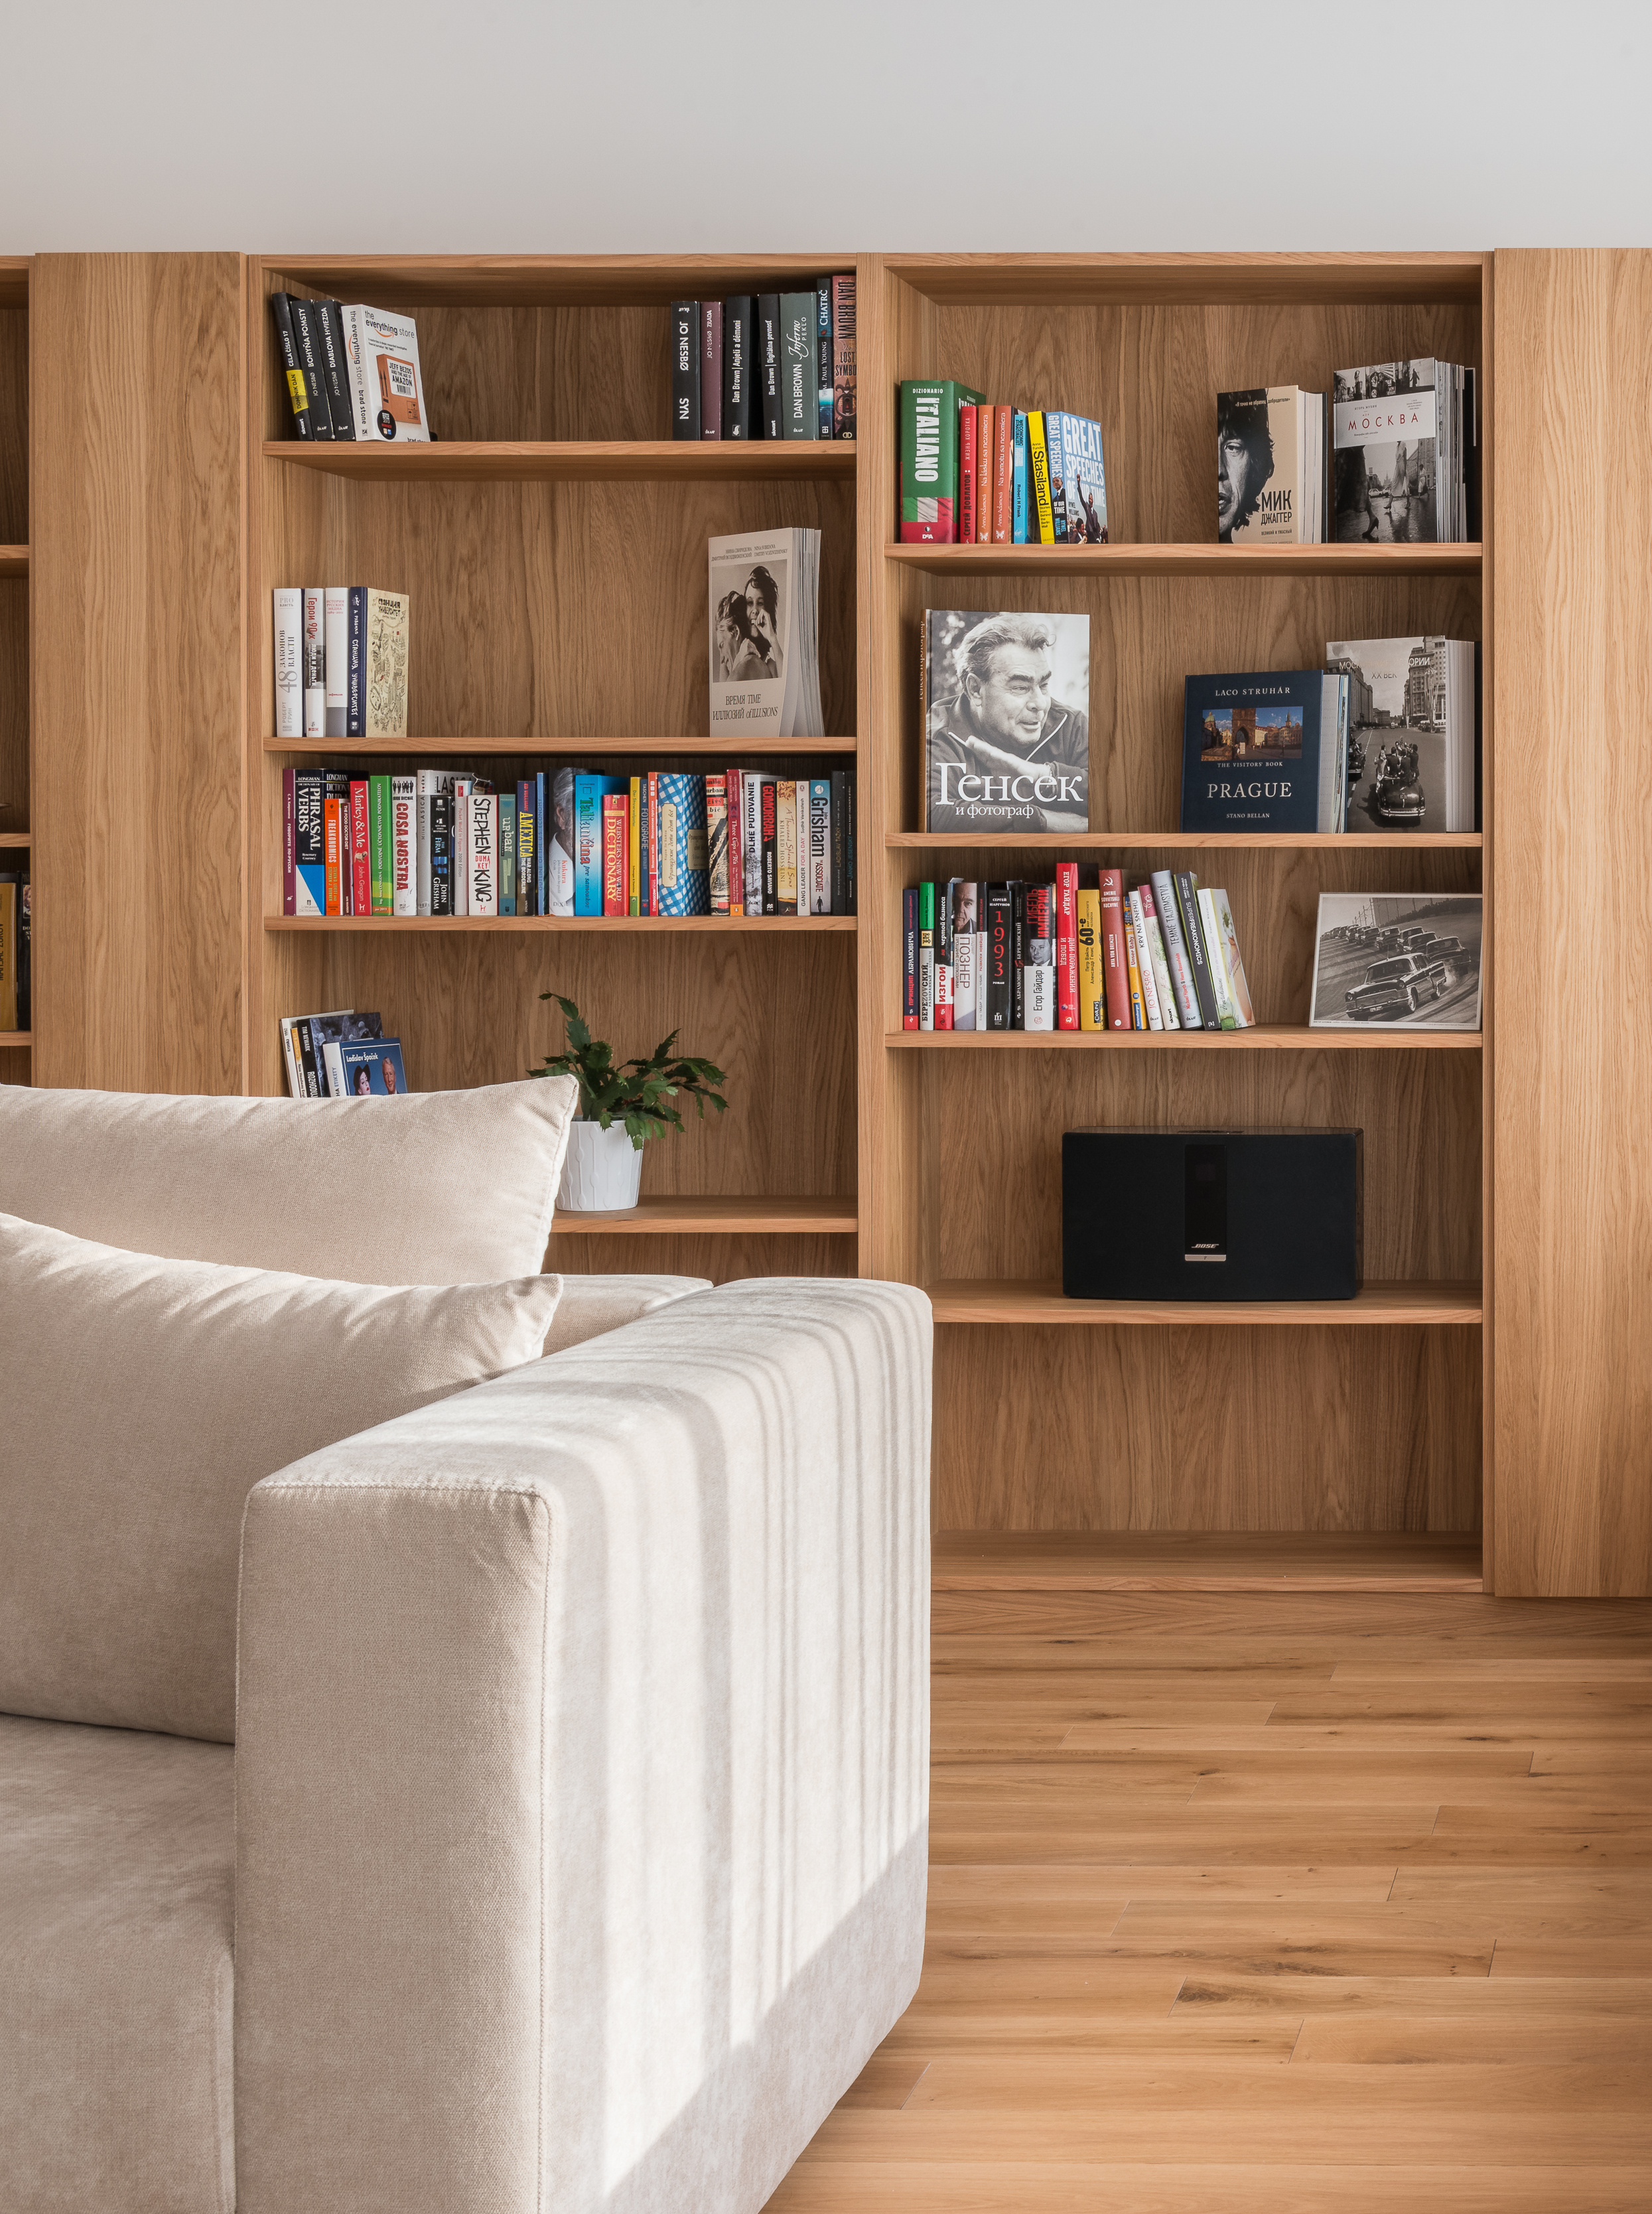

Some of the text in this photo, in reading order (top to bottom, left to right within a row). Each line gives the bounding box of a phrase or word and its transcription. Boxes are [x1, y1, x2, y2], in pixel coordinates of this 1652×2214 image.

[365, 311, 374, 320] the
[819, 290, 828, 326] CHATRČ
[838, 282, 856, 339] DAN BROWN
[299, 309, 314, 367] BOHYŇA POMSTY
[320, 307, 336, 368] DIABLOVA HVIEZDA
[352, 324, 361, 364] everything
[366, 320, 415, 338] everything store
[679, 321, 689, 334] JO
[679, 338, 689, 371] NESBØ
[841, 352, 855, 363] LOST
[392, 376, 412, 386] AMAZON
[793, 364, 802, 397] BROWN
[679, 398, 689, 419] SYN
[793, 398, 803, 418] DAN
[1348, 413, 1418, 431] МОСКВА
[915, 397, 939, 482] ITALIANO
[1048, 415, 1063, 478] GREAT SPEECHES
[1063, 415, 1101, 461] GREAT
[1034, 450, 1049, 506] Stasiland
[1066, 454, 1104, 486] SPEECHES
[1261, 512, 1292, 525] ДЖАГГЕР
[1262, 490, 1291, 512] МИК
[279, 671, 297, 693] 48
[726, 694, 761, 705] ВРЕМЯ TIME
[713, 707, 778, 720] ИЛЛЮЗИЙ of ILLUSIONS
[935, 762, 1084, 805] Генсек
[1207, 783, 1292, 798] PRAGUE
[299, 788, 309, 832] VERBS
[310, 788, 320, 850] PHRASAL
[355, 788, 364, 847] Marley & Me
[396, 803, 408, 836] COSA
[474, 799, 491, 854] STEPHEN
[763, 786, 774, 838] GOMORRAH
[811, 797, 828, 857] Grisham
[955, 804, 1034, 819] и фотограф
[519, 812, 533, 857] AMEXICA
[580, 797, 594, 864] Taliančina
[397, 837, 408, 890] NOSTRA
[607, 819, 616, 902] DICTIONARY
[474, 870, 492, 902] KING
[1161, 884, 1174, 922] TAJOMSTVÁ
[1027, 889, 1038, 924] ГИБЕЛЬ
[1038, 890, 1049, 937] ИМПЕРИИ
[1168, 923, 1179, 945] TEMNÉ
[1186, 902, 1202, 965] SUPERFREAKONOMICS
[960, 937, 970, 988] ПОЗНЕР
[1034, 970, 1044, 1011] Егор Гайдар
[1143, 970, 1156, 1008] JO NESBØ
[364, 1052, 378, 1062] Špaček
